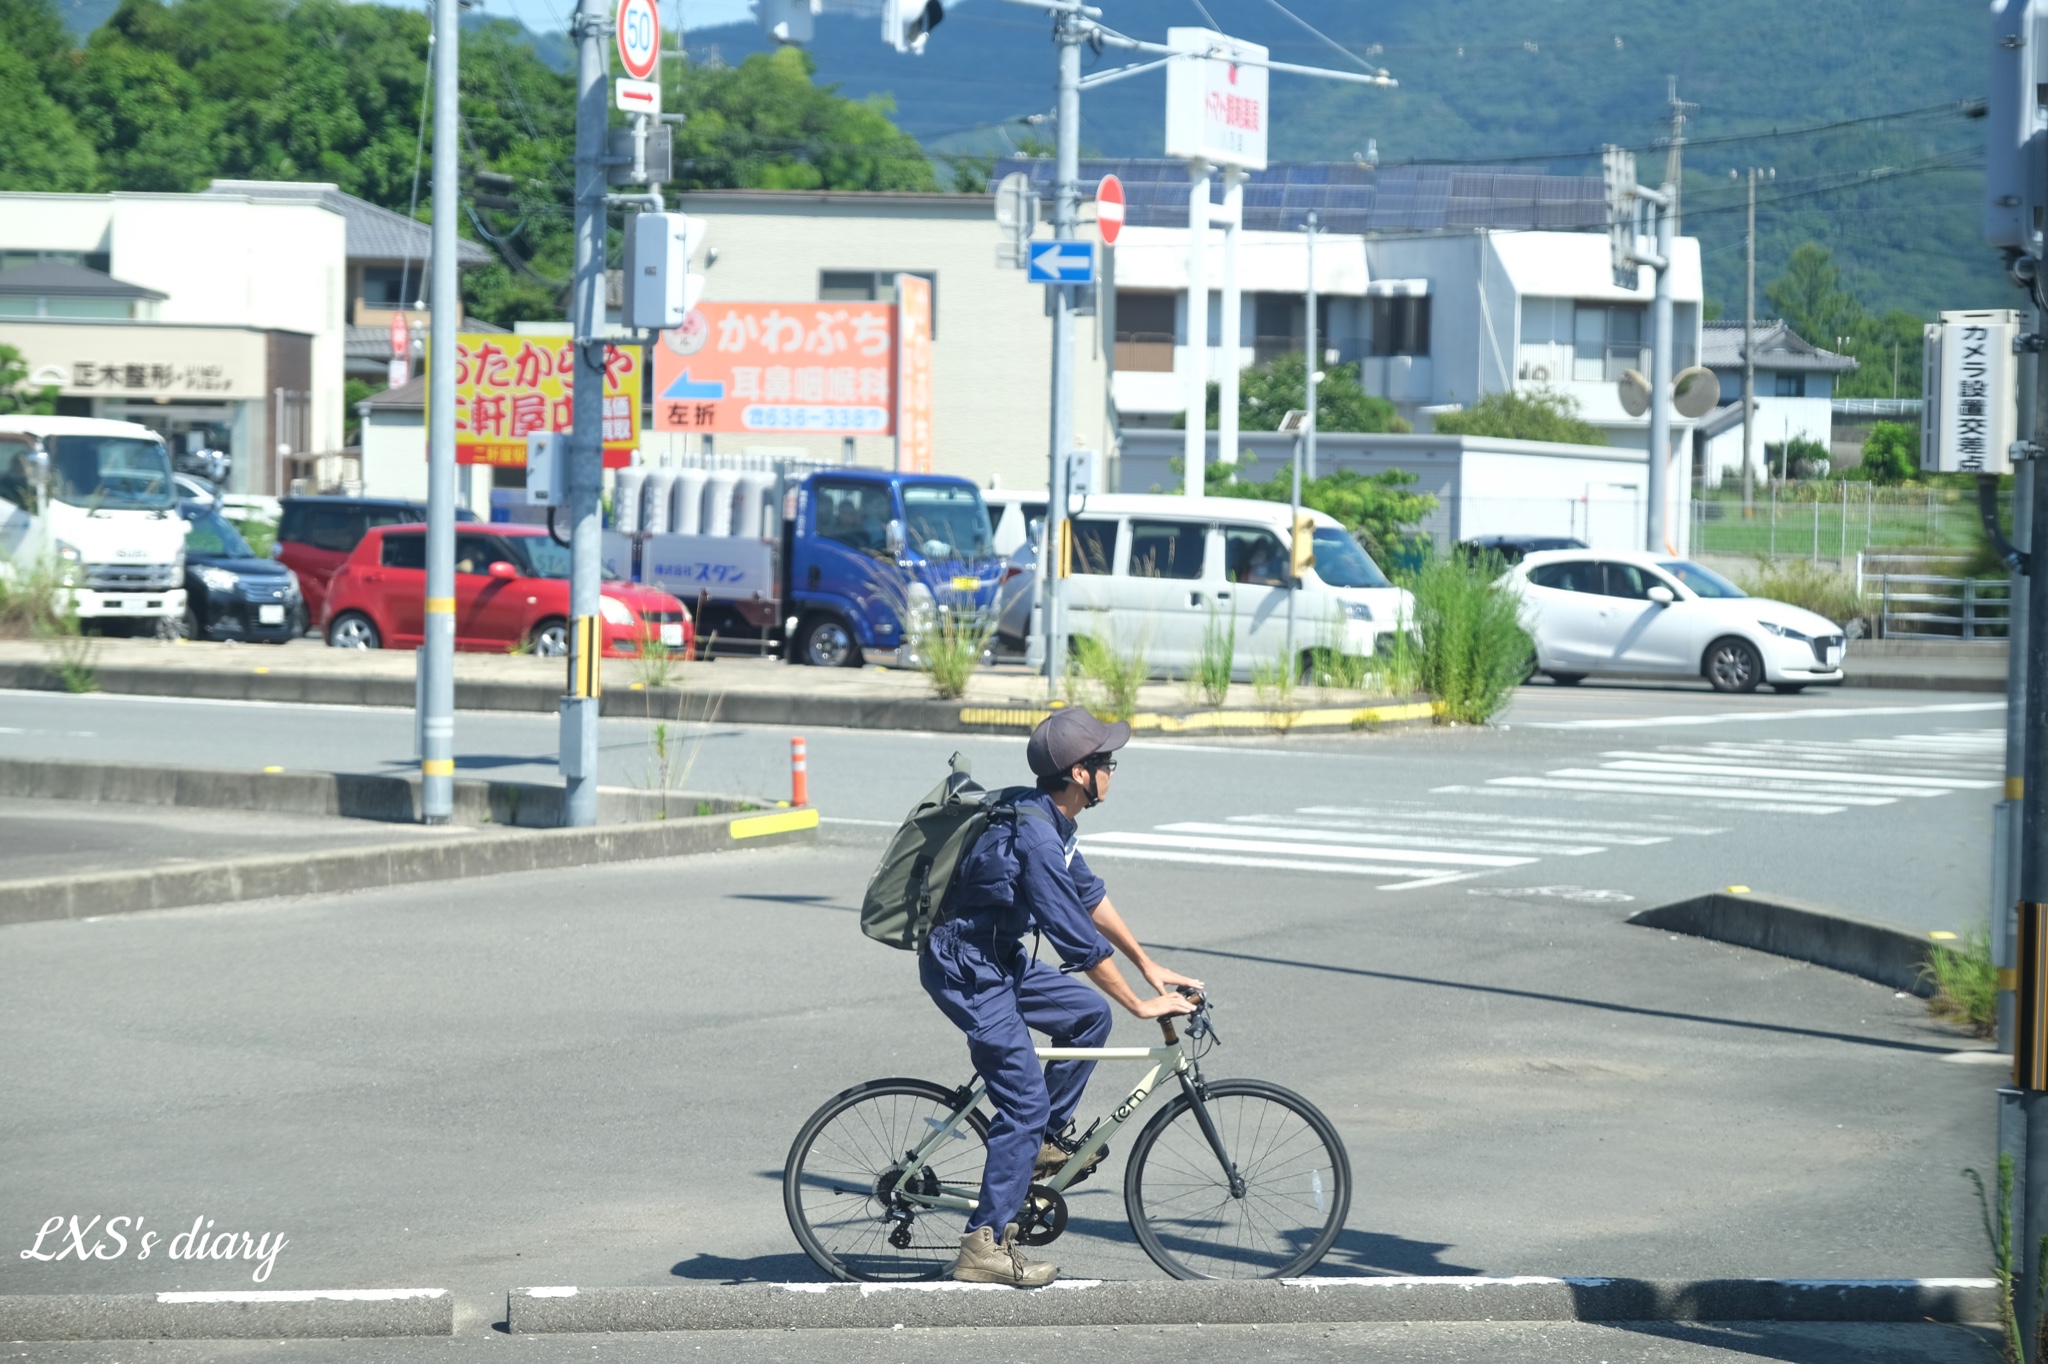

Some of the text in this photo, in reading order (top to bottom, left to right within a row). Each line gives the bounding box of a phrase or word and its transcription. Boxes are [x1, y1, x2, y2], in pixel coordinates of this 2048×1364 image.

[628, 9, 650, 51] 50
[716, 308, 890, 356] かわぶち
[730, 364, 890, 402] 耳鼻咽喉科
[1957, 325, 1989, 473] カメラ設置交差点
[667, 403, 715, 426] 左折
